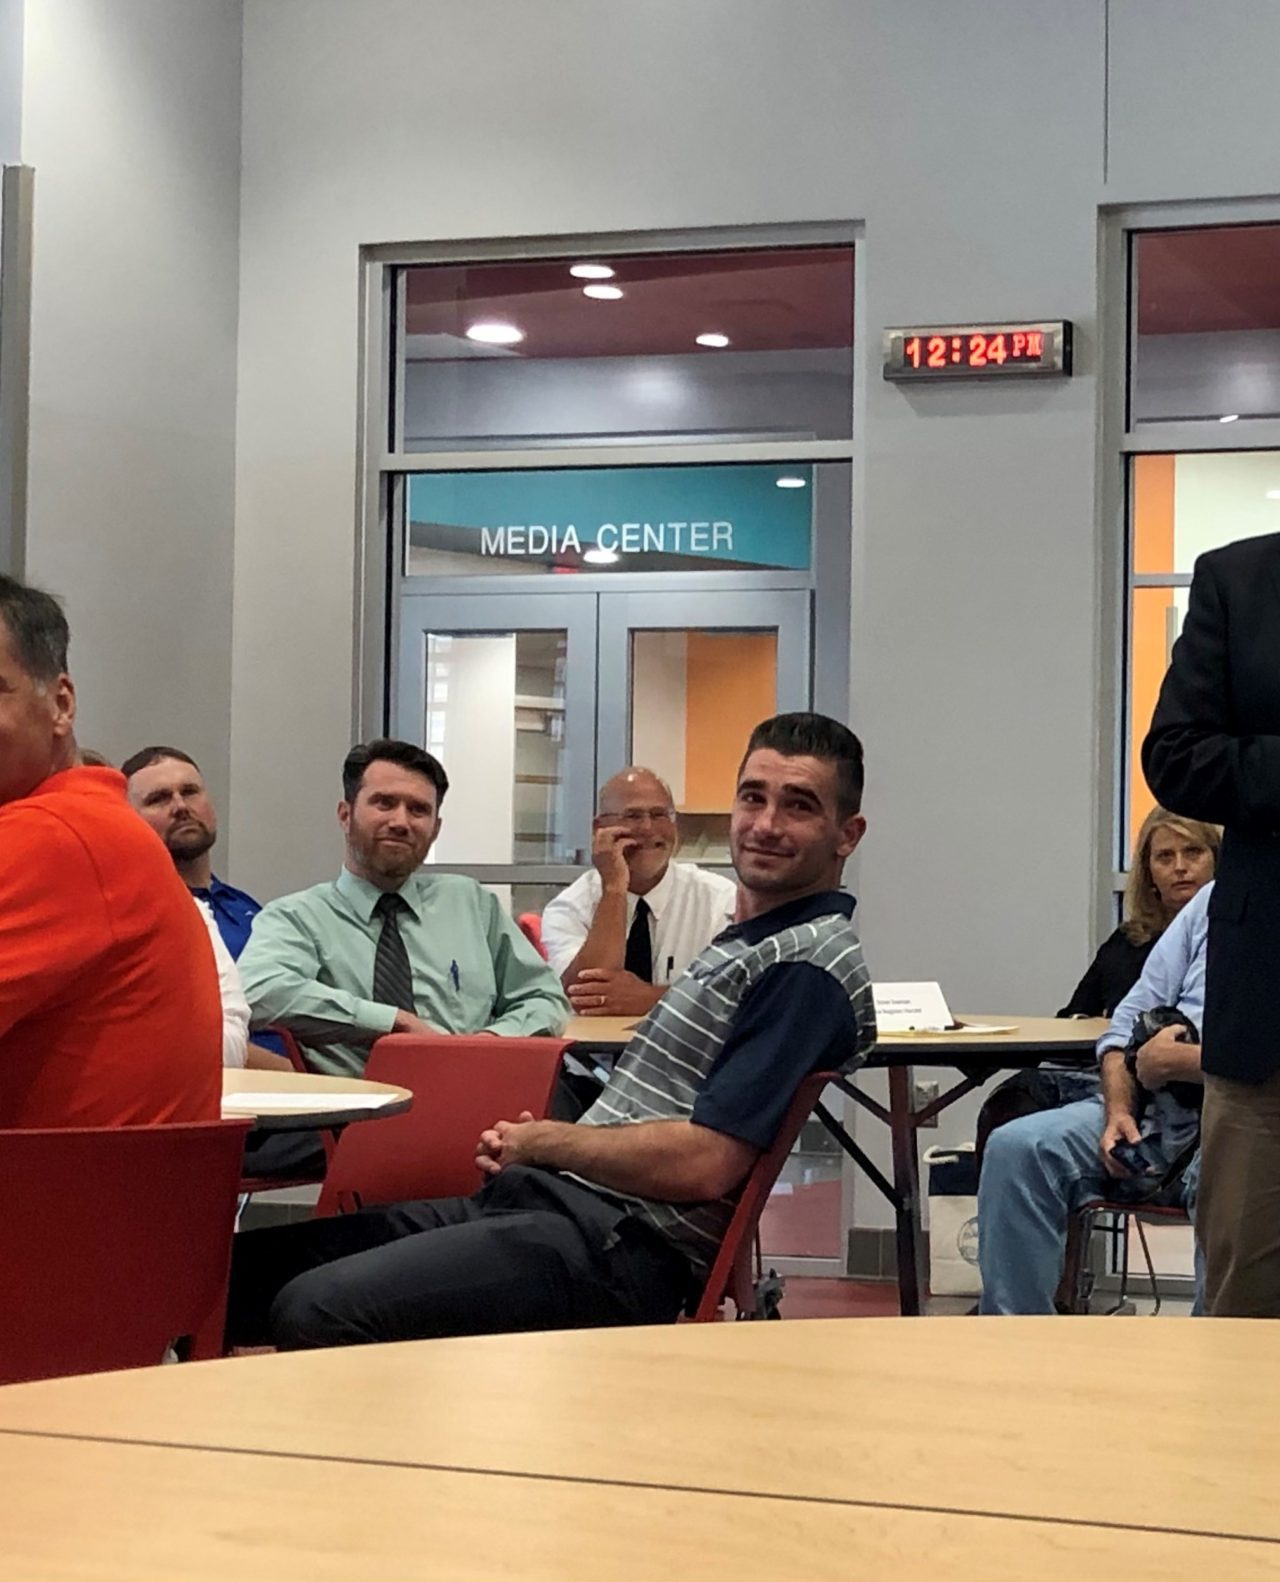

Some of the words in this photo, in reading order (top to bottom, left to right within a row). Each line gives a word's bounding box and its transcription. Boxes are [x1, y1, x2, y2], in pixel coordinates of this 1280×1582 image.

[906, 333, 1006, 368] 12:24
[1012, 331, 1043, 357] PM
[480, 524, 581, 556] MEDIA
[596, 521, 734, 552] CENTER
